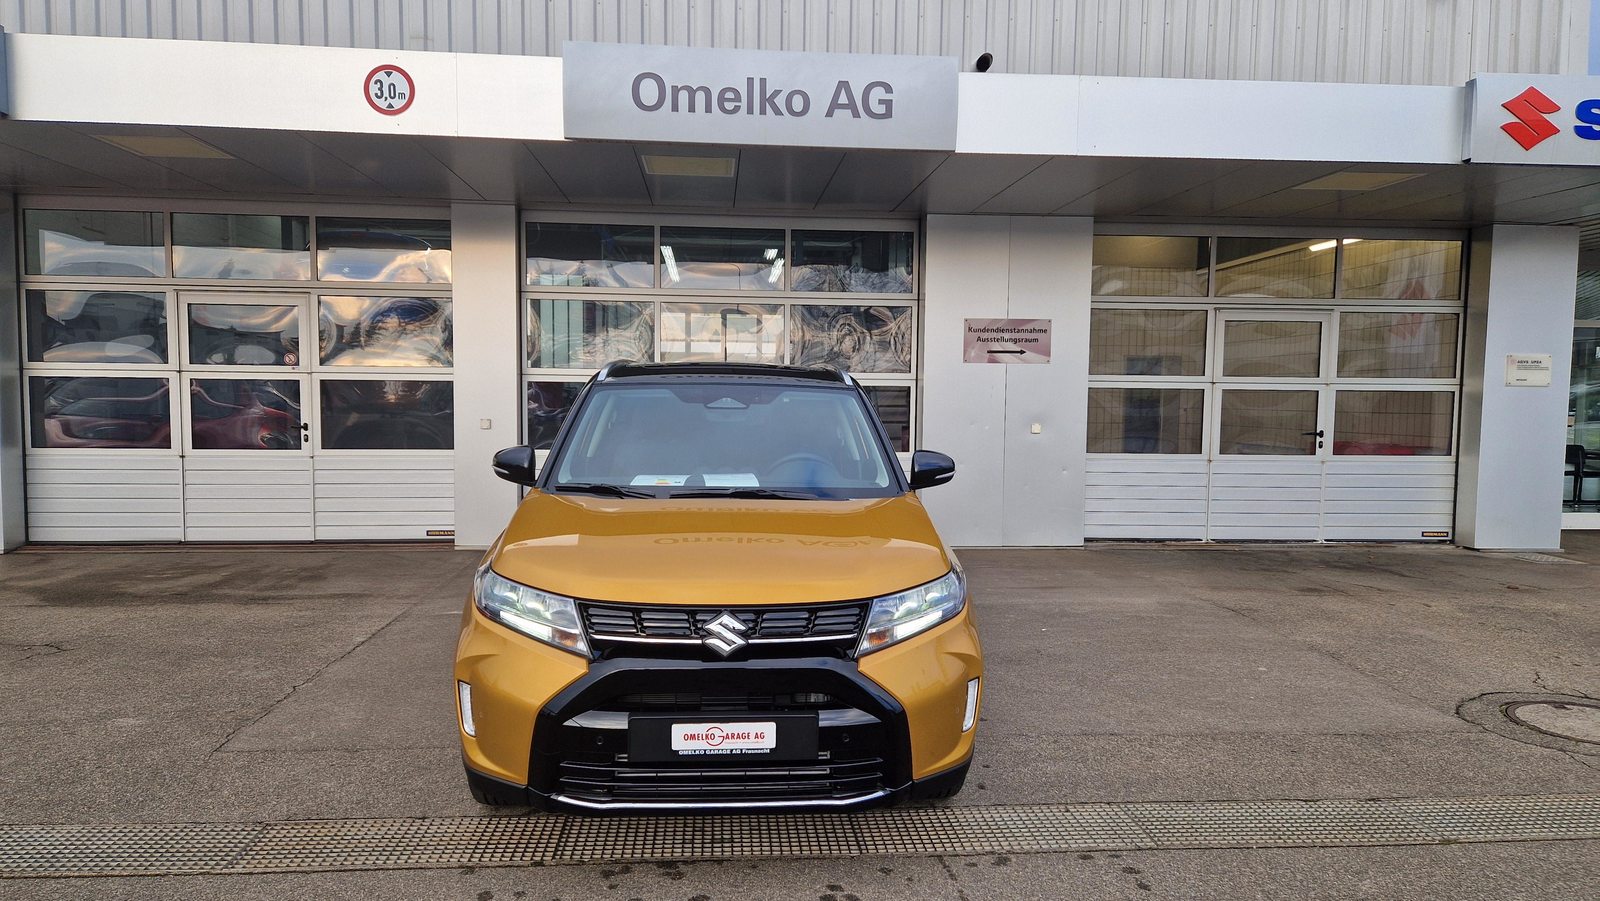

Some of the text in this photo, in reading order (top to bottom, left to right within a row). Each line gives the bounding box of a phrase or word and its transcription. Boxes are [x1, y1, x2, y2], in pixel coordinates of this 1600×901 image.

[631, 71, 895, 120] Omelko AG
[968, 326, 1048, 334] Kundendienstannahme
[976, 335, 1039, 344] Ausstellungsraum
[683, 732, 716, 742] OMELKO
[754, 731, 766, 741] AG
